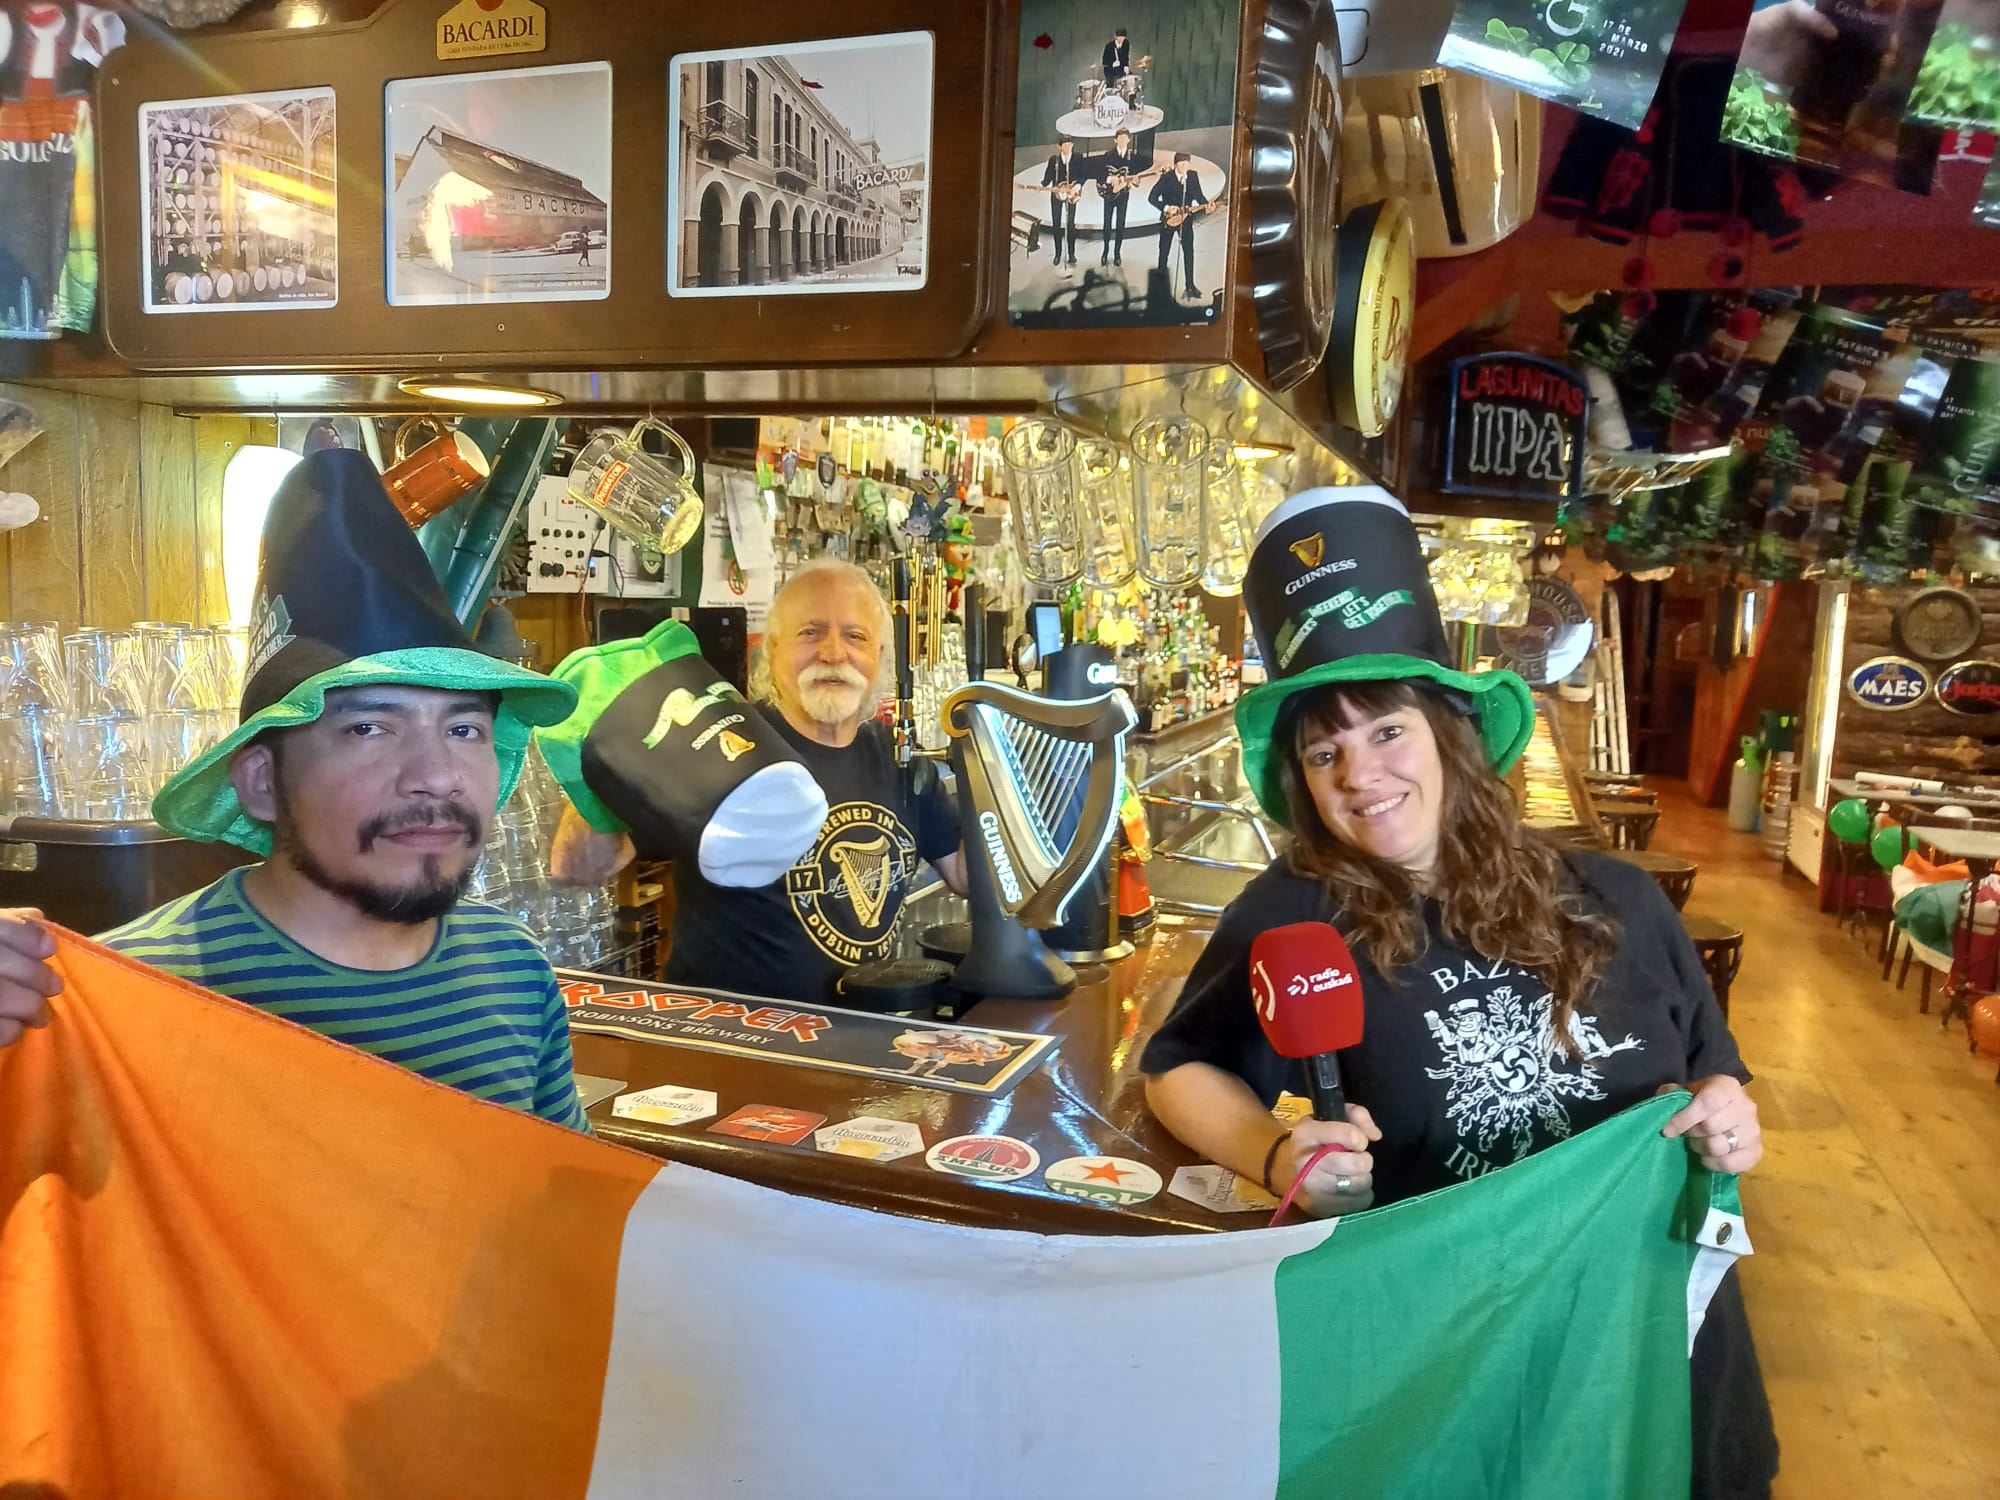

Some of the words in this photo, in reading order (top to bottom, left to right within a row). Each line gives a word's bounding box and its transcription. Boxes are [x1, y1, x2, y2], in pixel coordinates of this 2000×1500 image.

[442, 15, 534, 44] BACARDI
[1603, 19, 1615, 29] 17
[1618, 23, 1632, 36] DE
[1599, 42, 1625, 58] 2021
[1610, 33, 1648, 53] MARZO
[854, 167, 914, 191] BACARDI
[1460, 365, 1584, 416] LAGUNITAS
[1468, 402, 1569, 481] IPA
[596, 463, 626, 504] PRIMATOR
[1284, 558, 1358, 596] GUINNESS
[1342, 596, 1370, 618] LET'S
[1858, 678, 1922, 697] MAES
[691, 713, 746, 751] GUINNESS
[816, 807, 872, 842] BREWED
[876, 812, 895, 831] IN
[980, 811, 1022, 903] GUINNESS
[794, 871, 814, 889] 17
[807, 913, 862, 960] DUBLIN
[1309, 967, 1340, 983] radio
[1313, 973, 1353, 992] euskadi
[570, 1009, 678, 1031] ROBINSONS
[682, 1025, 775, 1045] BREWERY
